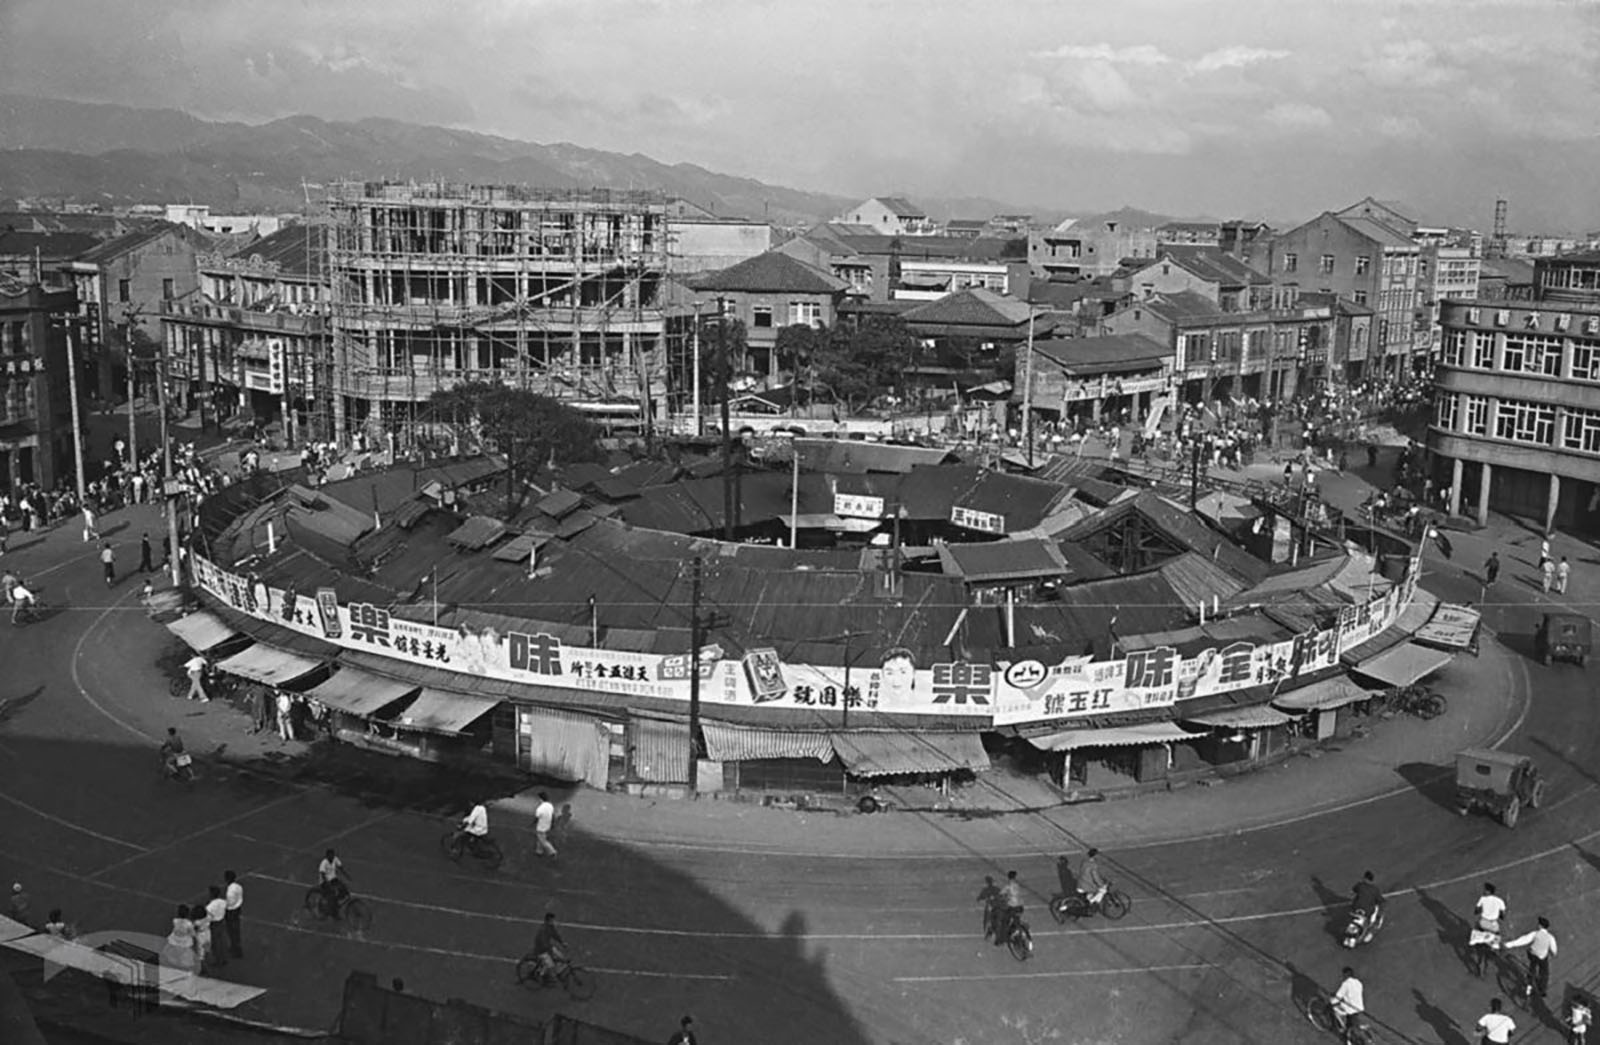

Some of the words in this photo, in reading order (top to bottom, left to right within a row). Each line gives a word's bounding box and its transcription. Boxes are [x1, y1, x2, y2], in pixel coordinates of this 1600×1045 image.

[349, 602, 391, 648] 樂
[508, 630, 562, 677] 味
[1125, 646, 1176, 689] 味
[1219, 641, 1255, 684] 全
[932, 660, 991, 705] 樂
